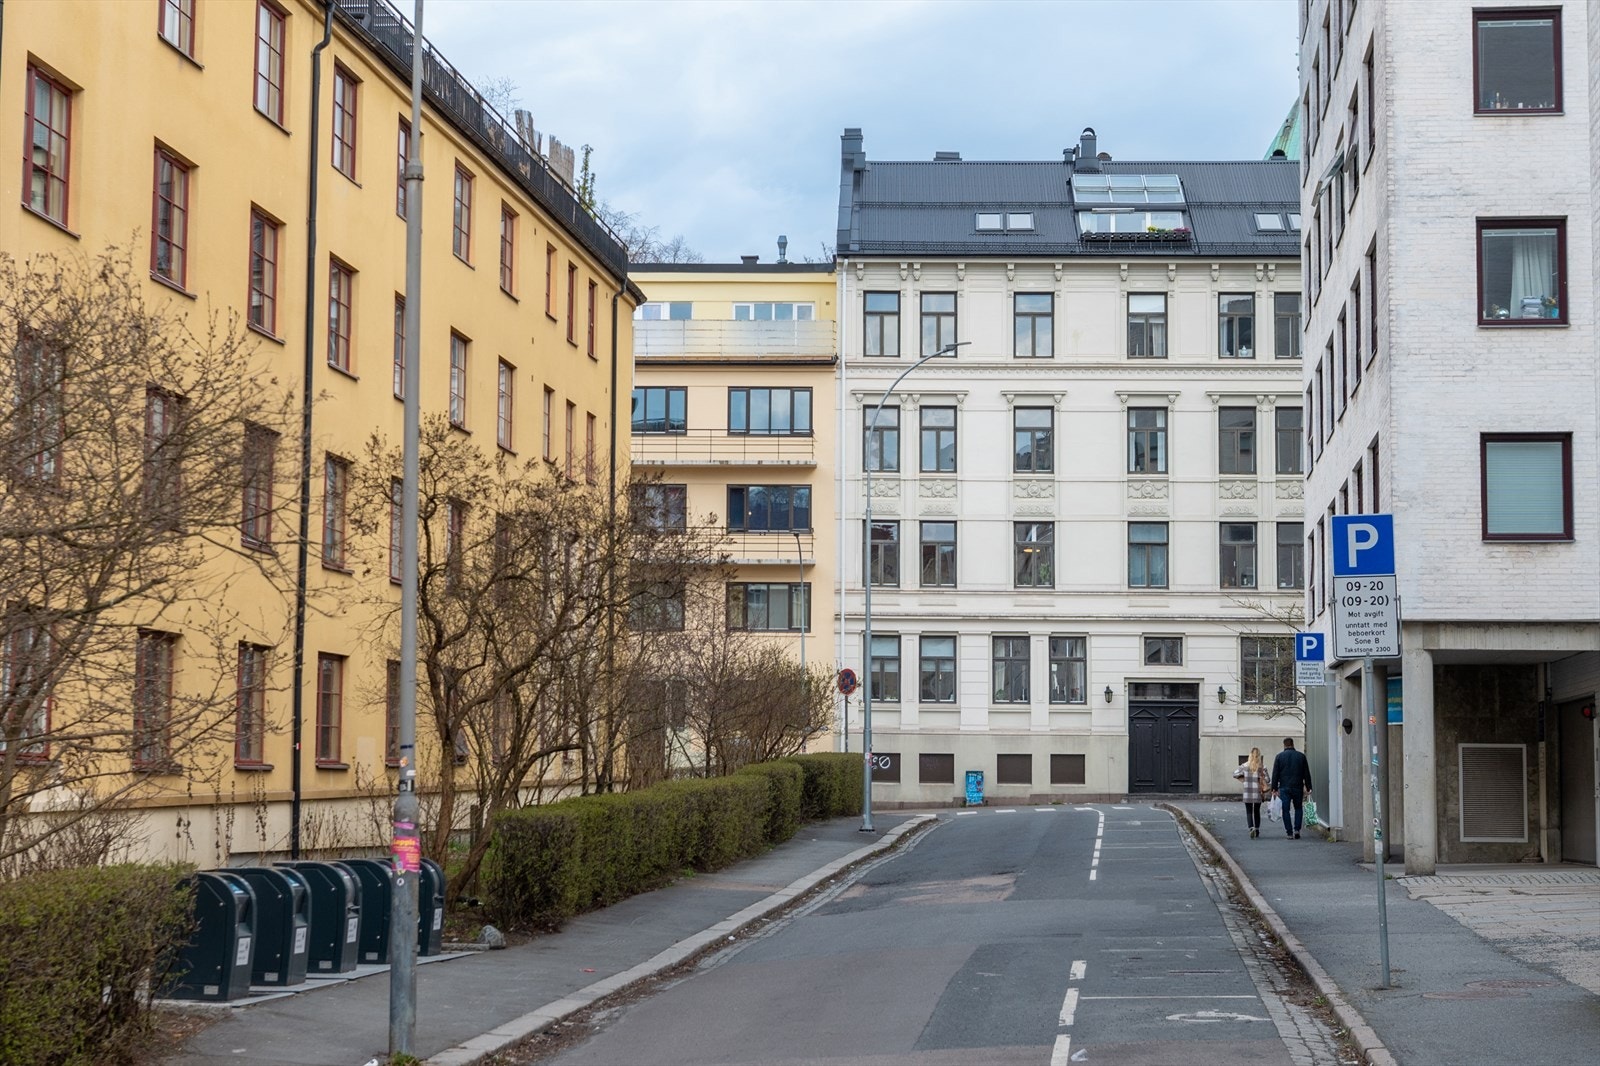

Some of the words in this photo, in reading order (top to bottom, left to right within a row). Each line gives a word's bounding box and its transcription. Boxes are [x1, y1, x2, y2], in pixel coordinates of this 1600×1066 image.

[1347, 523, 1379, 568] P
[1302, 636, 1318, 658] P
[1218, 714, 1224, 723] 9
